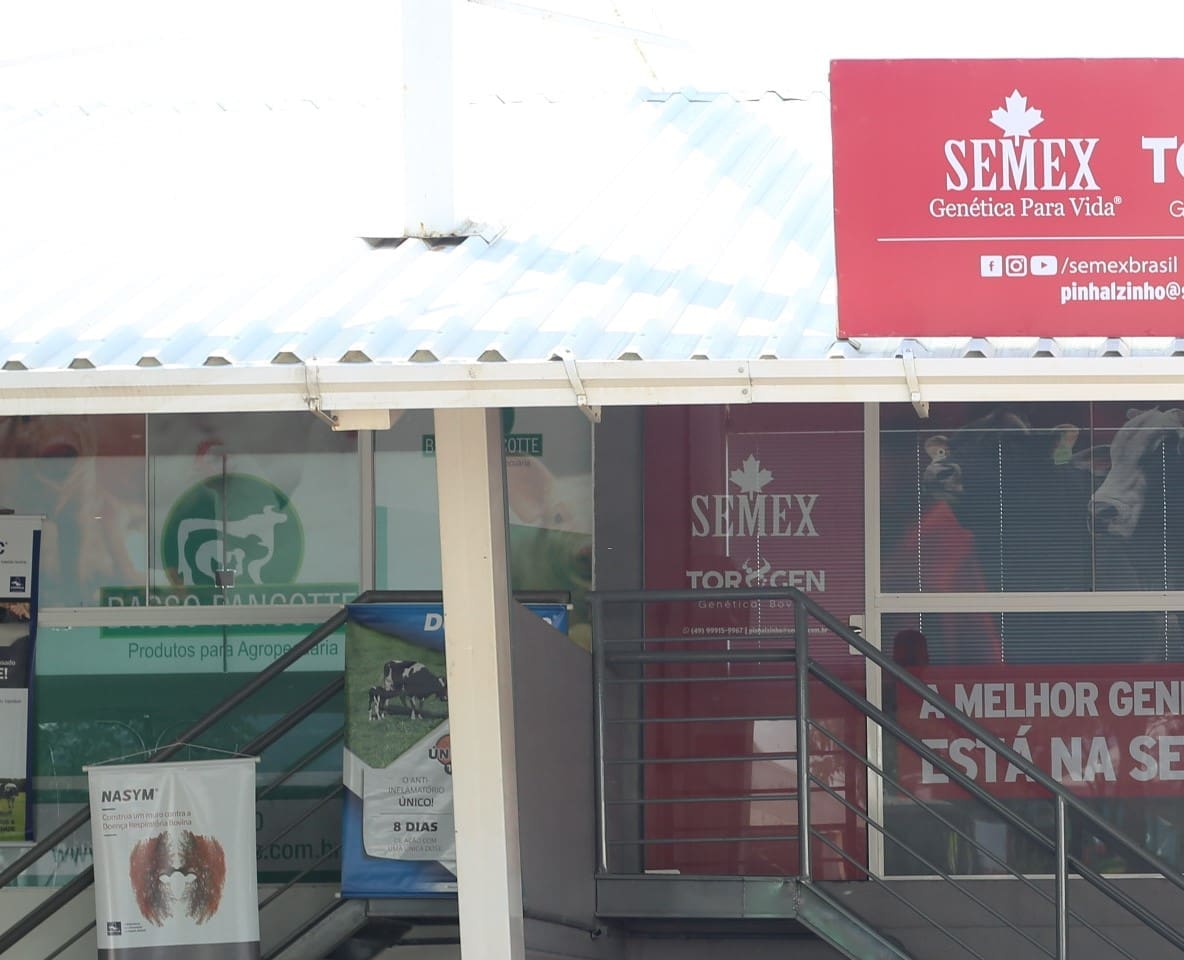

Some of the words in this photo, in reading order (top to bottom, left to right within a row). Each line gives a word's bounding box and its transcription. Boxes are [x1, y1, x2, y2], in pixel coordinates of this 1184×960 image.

[945, 138, 1100, 191] SEMEX
[929, 197, 1016, 219] Genética
[1020, 198, 1066, 217] Para
[691, 494, 820, 537] SEMEX
[698, 598, 758, 609] Genética
[128, 643, 196, 660] Produtos
[200, 644, 234, 660] para
[920, 684, 945, 719] A
[955, 682, 1099, 719] MELHOR
[920, 725, 1035, 784] ESTÁ
[1051, 736, 1118, 782] NA
[399, 796, 435, 807] ÚNICO!
[102, 821, 128, 832] Doença
[393, 822, 401, 832] 8
[405, 821, 439, 832] DIAS
